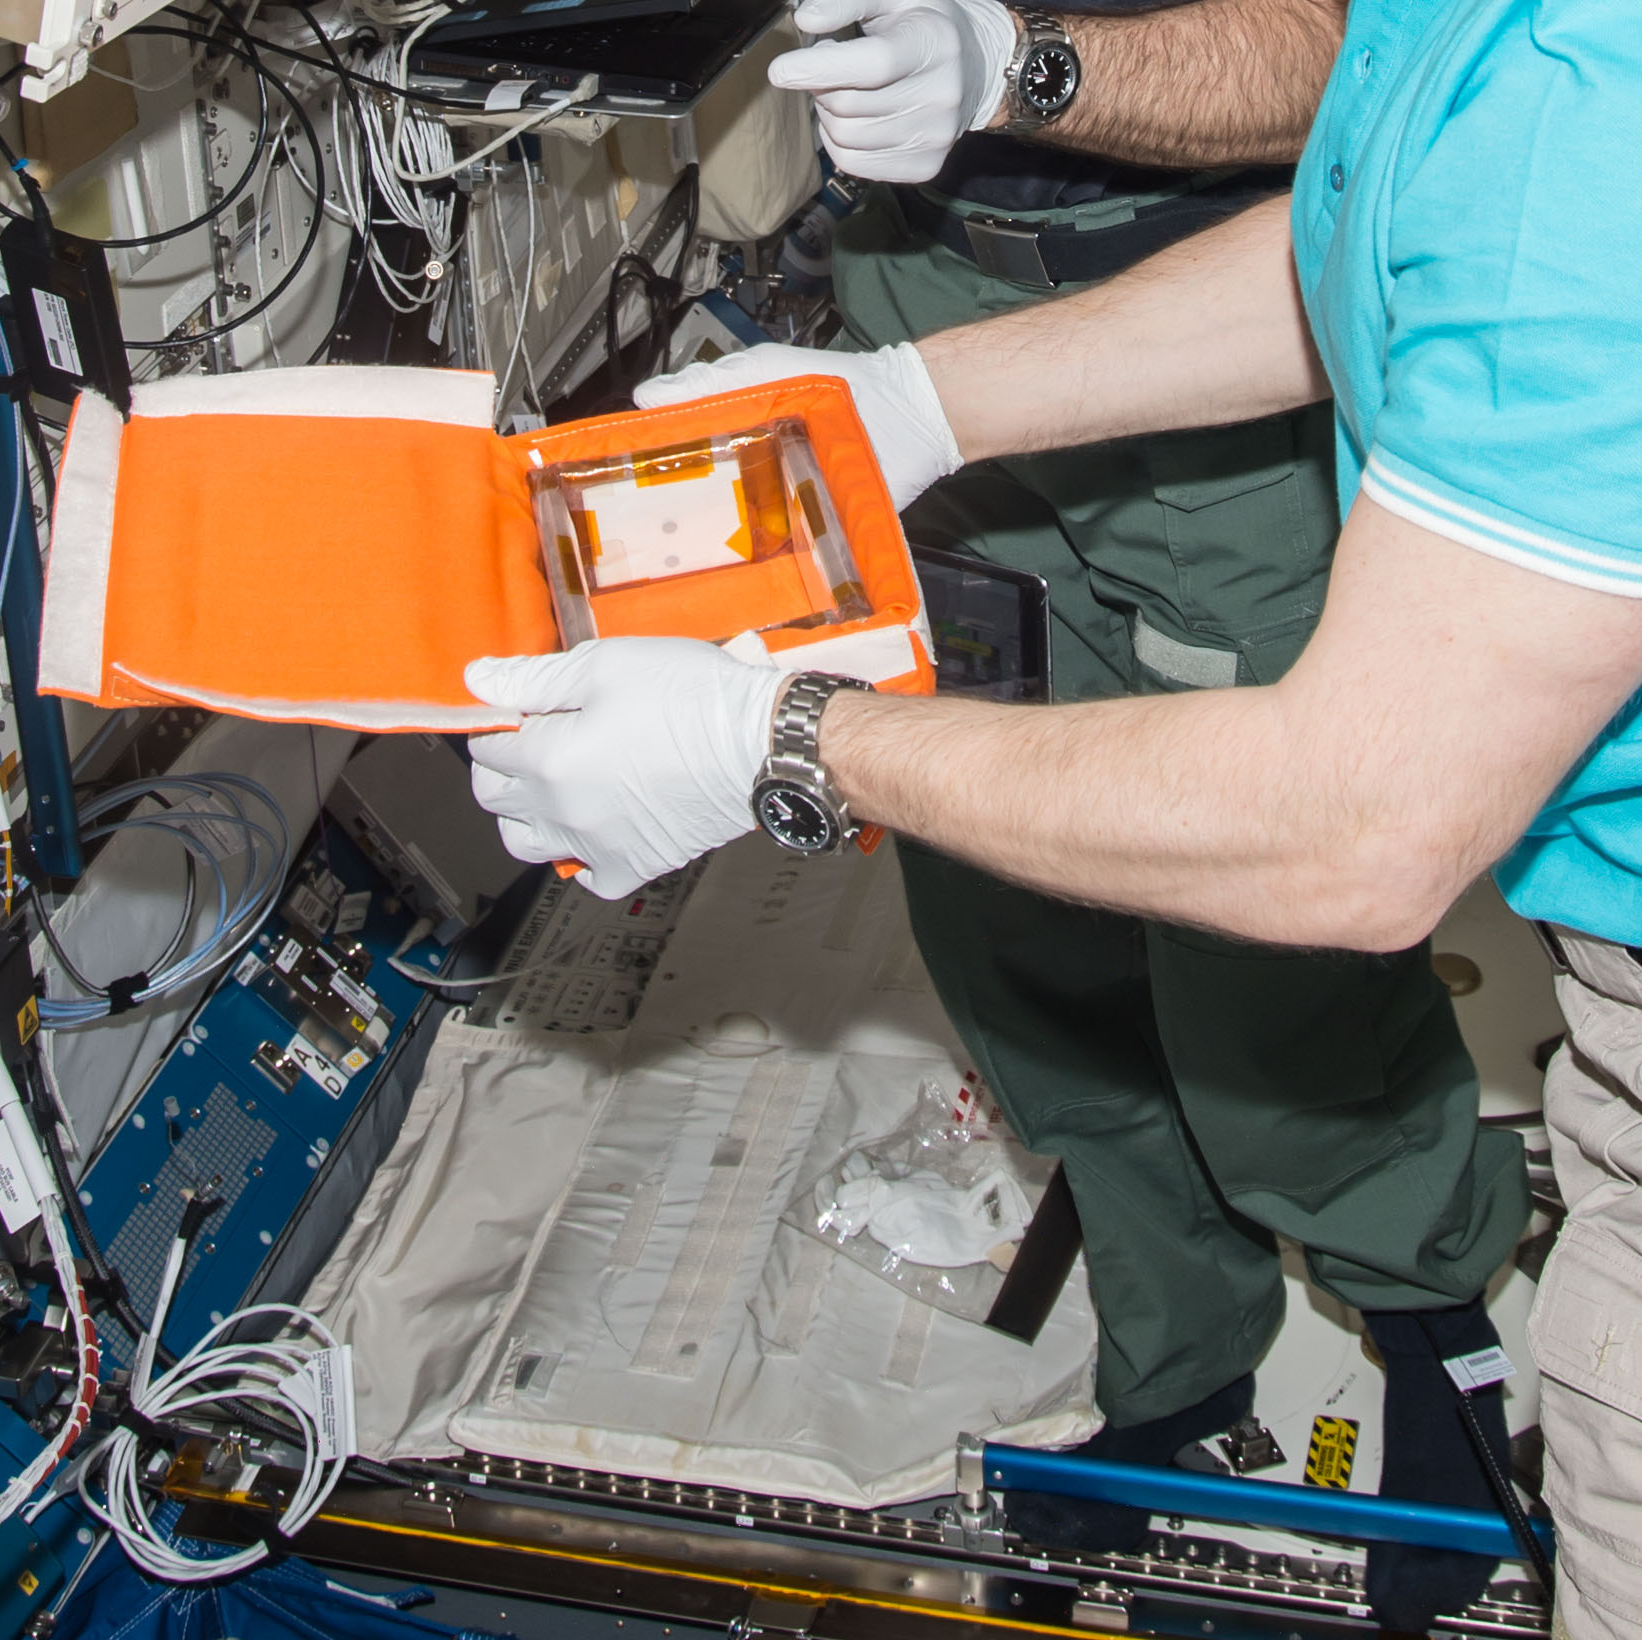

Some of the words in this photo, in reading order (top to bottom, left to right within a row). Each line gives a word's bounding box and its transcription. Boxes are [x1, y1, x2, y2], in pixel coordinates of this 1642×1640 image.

[517, 907, 549, 951] EIGHTY
[540, 883, 563, 910] LAB
[294, 1048, 312, 1067] A
[313, 1055, 331, 1072] 4
[323, 1076, 342, 1096] D
